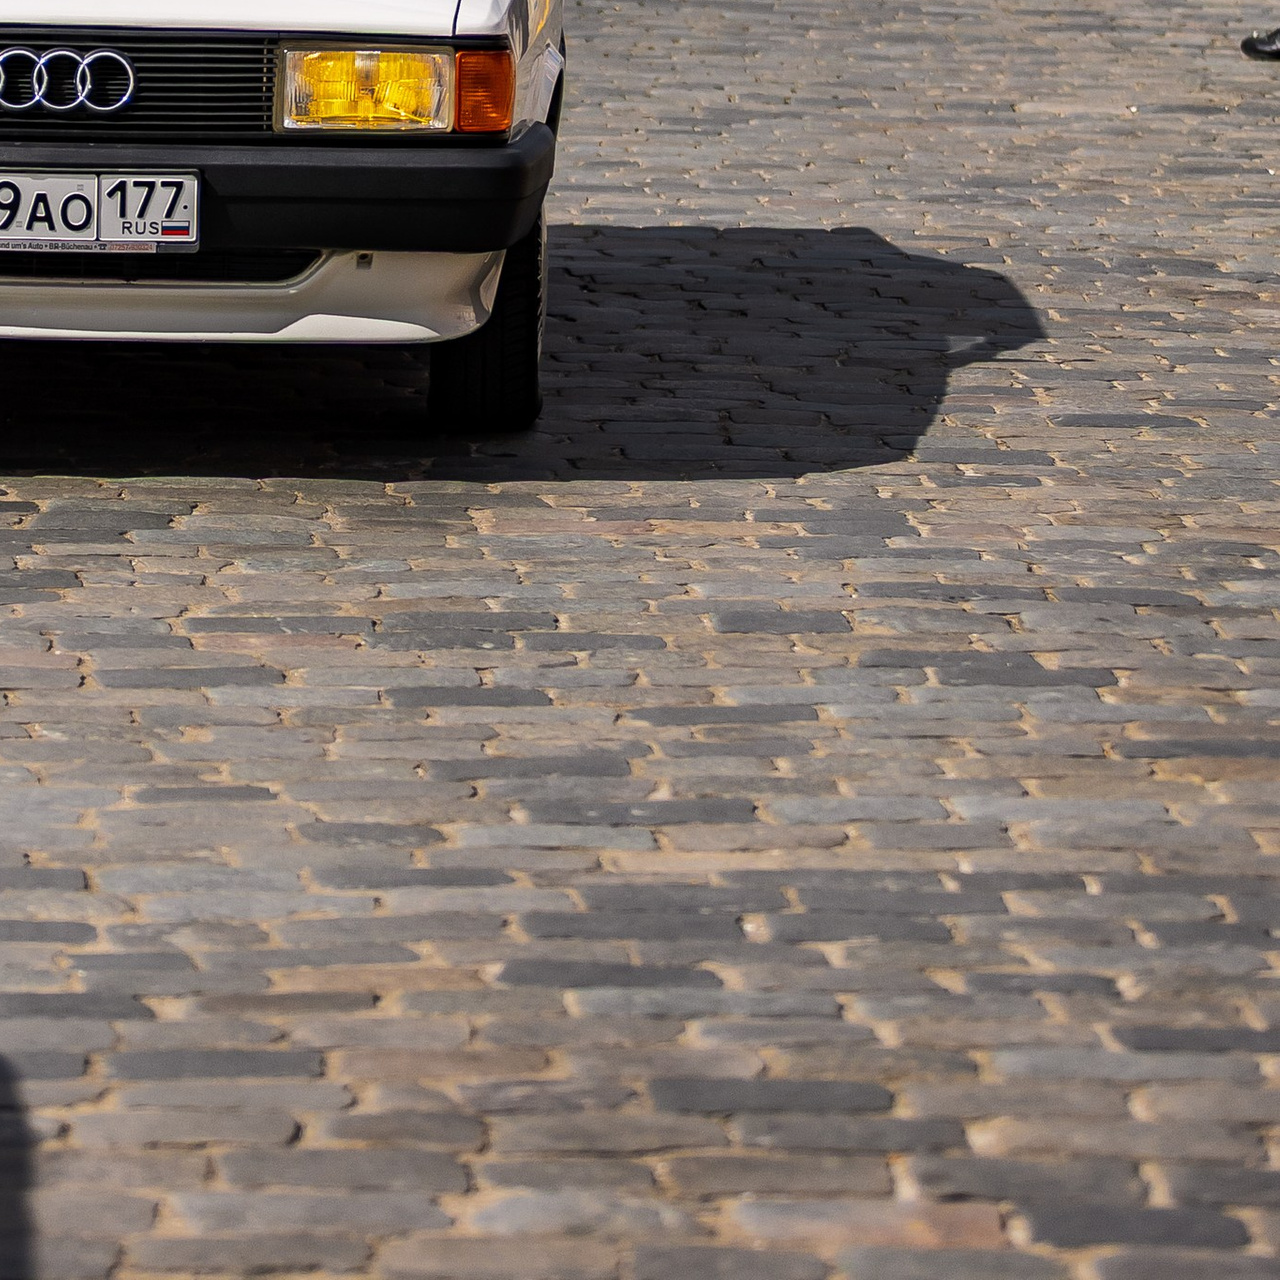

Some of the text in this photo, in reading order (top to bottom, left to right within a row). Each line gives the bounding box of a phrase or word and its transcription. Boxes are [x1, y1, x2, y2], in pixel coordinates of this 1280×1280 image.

[105, 180, 184, 218] 177
[122, 221, 159, 235] RUS
[27, 242, 43, 250] Auto
